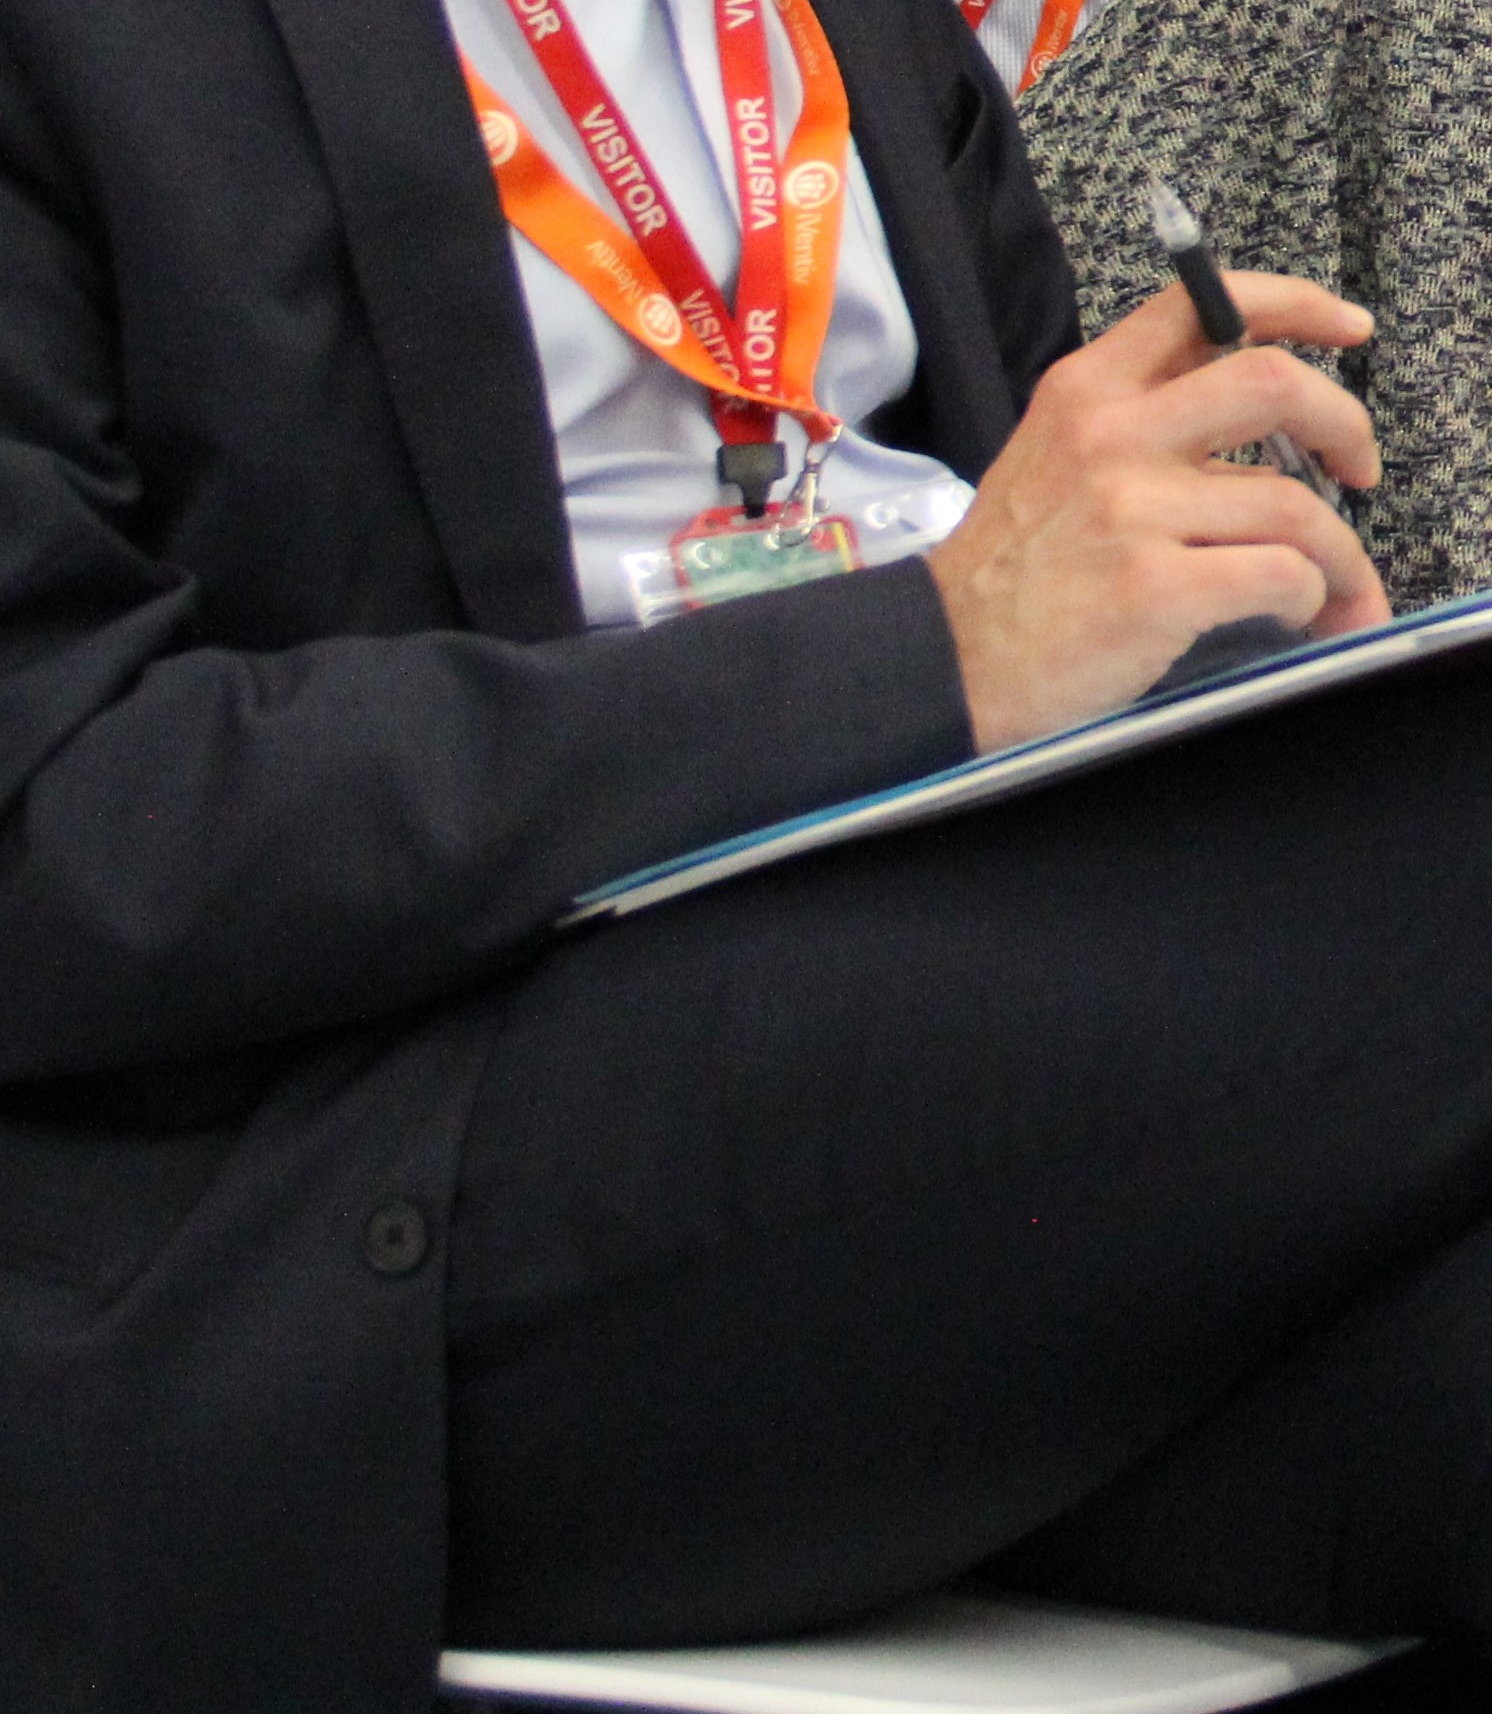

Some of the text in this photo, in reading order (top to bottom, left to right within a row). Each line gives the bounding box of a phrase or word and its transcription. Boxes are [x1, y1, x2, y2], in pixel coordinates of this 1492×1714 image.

[581, 103, 668, 238] VISITOR
[736, 96, 778, 231] VISITOR
[793, 211, 823, 284] iVentiv
